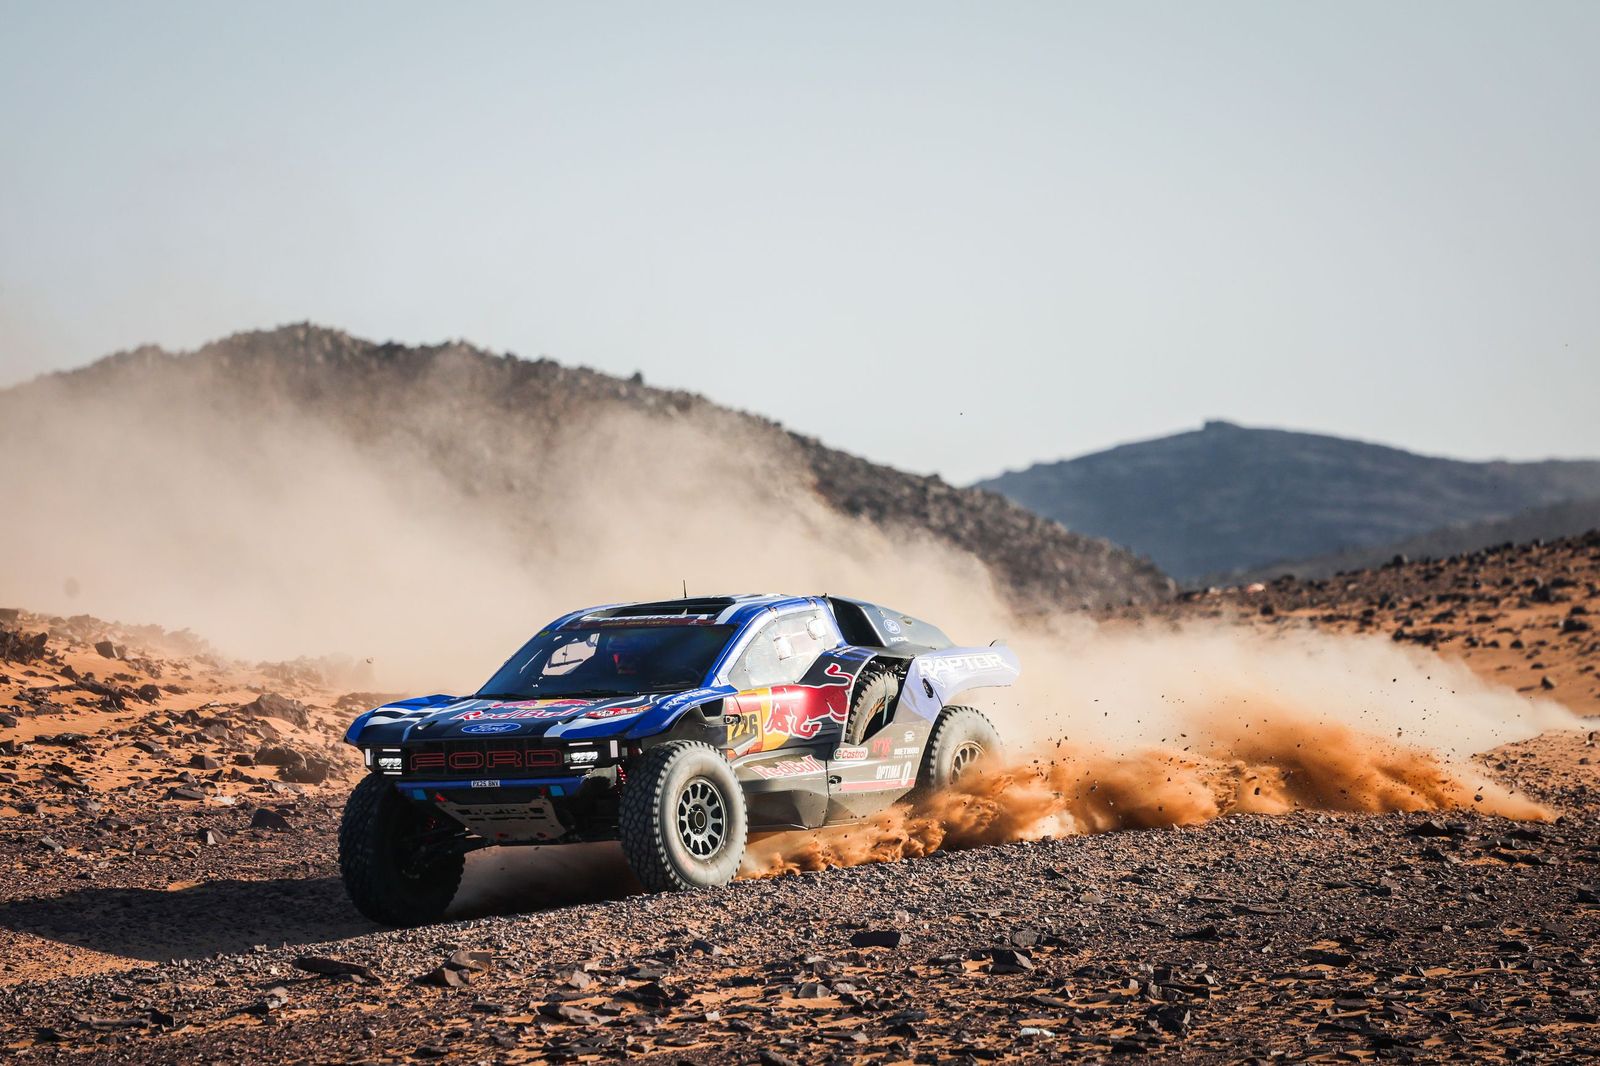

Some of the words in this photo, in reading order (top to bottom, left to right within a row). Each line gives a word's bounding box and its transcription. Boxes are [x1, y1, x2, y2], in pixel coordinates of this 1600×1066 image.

[918, 654, 1003, 680] RAPTOR
[468, 723, 514, 733] Ford
[410, 749, 563, 771] FORD
[842, 749, 867, 759] Castrol
[875, 765, 901, 780] OPTIMA
